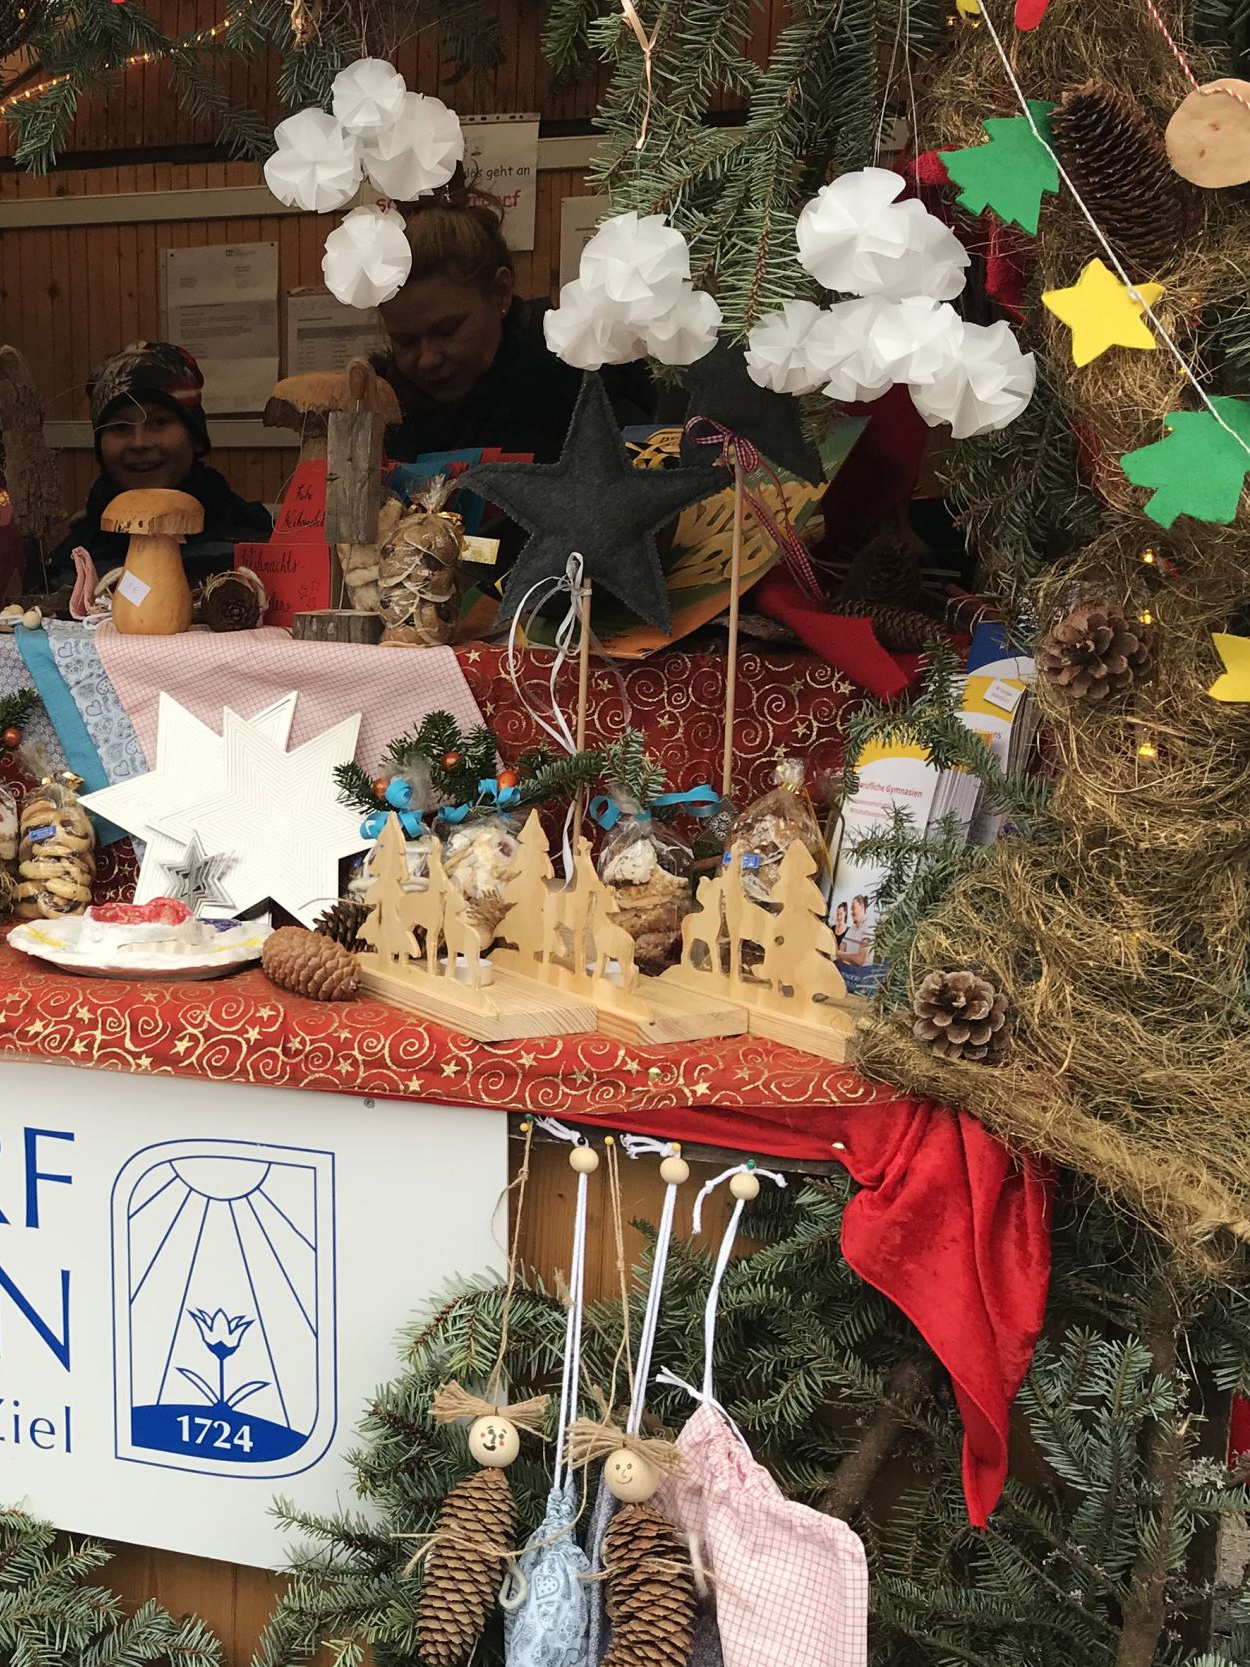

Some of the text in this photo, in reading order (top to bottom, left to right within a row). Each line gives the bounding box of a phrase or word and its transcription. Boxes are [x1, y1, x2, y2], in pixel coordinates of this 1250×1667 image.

[486, 165, 512, 181] geht
[516, 166, 530, 177] an
[886, 784, 923, 799] Gymnasien
[176, 1414, 254, 1454] 1724
